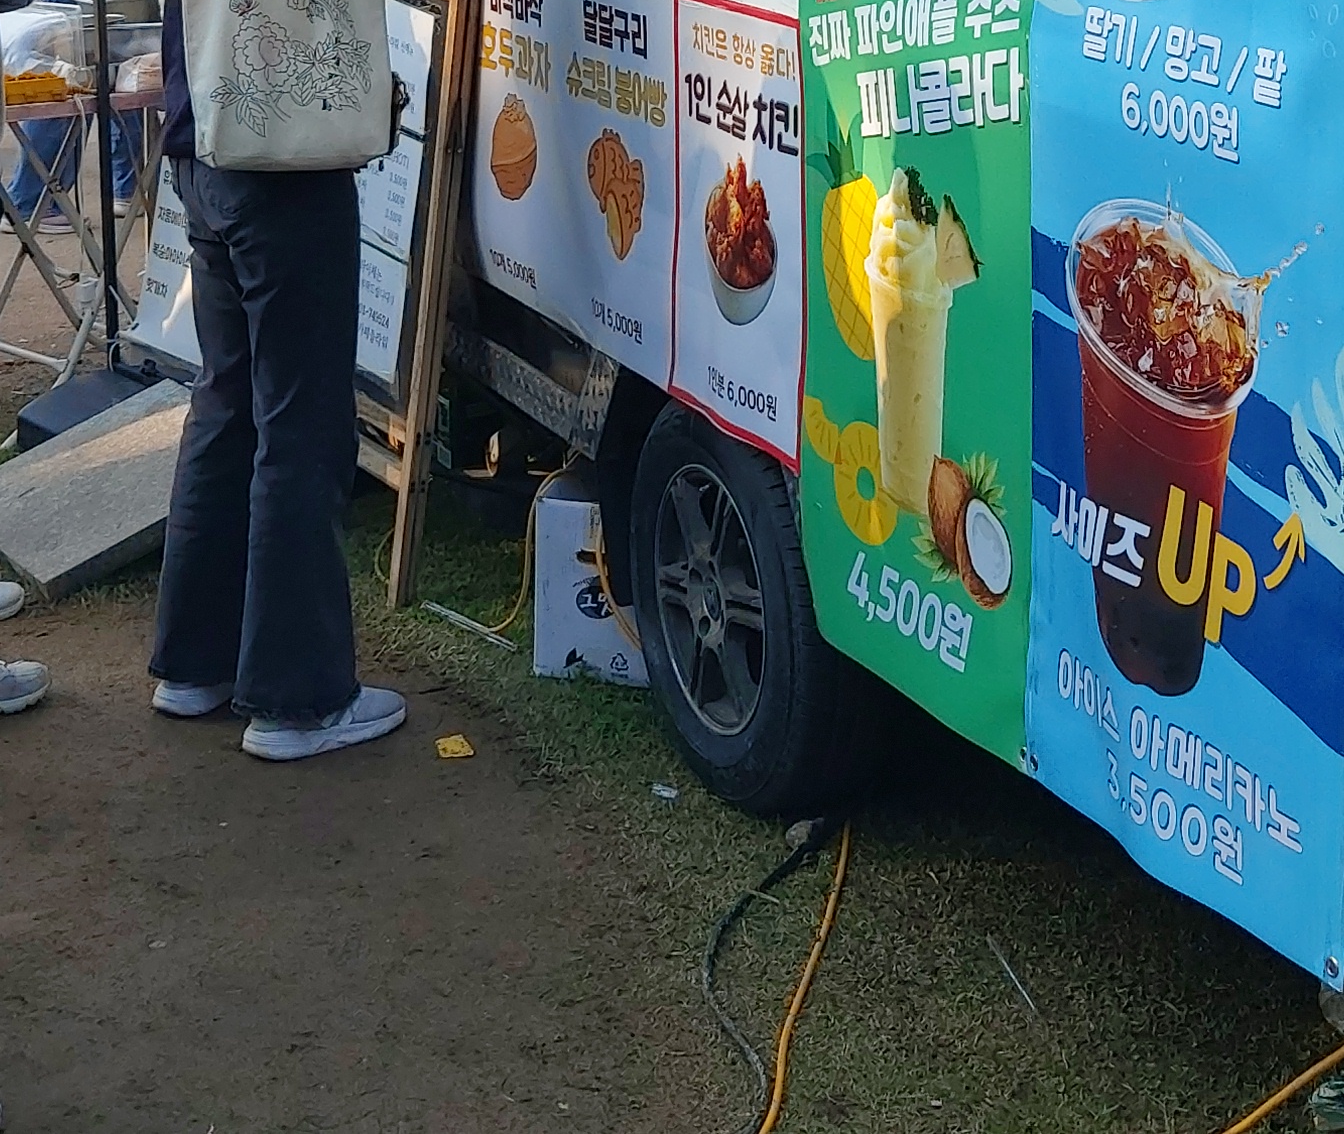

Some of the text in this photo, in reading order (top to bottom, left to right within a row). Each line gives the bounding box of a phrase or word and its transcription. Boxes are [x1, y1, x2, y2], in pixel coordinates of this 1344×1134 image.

[481, 21, 552, 93] 호두과자
[691, 22, 729, 61] 치킨은
[731, 33, 757, 70] 항상
[808, 9, 852, 67] 진짜
[1082, 5, 1139, 70] 딸기
[1164, 24, 1223, 88] 망고
[1253, 46, 1288, 109] 팥
[566, 51, 668, 128] 슈크림 붕어빵
[684, 73, 800, 157] 1인 순살 치킨
[856, 47, 1025, 139] 피나콜라다
[1120, 82, 1240, 164] 6,000원
[607, 307, 643, 346] 5,000원
[726, 380, 778, 423] 6,000원
[1051, 479, 1258, 644] 사이즈 UP
[846, 550, 974, 674] 4,500원
[1056, 647, 1305, 855] 아이스 아메리카노
[1106, 748, 1245, 886] 3,500원
